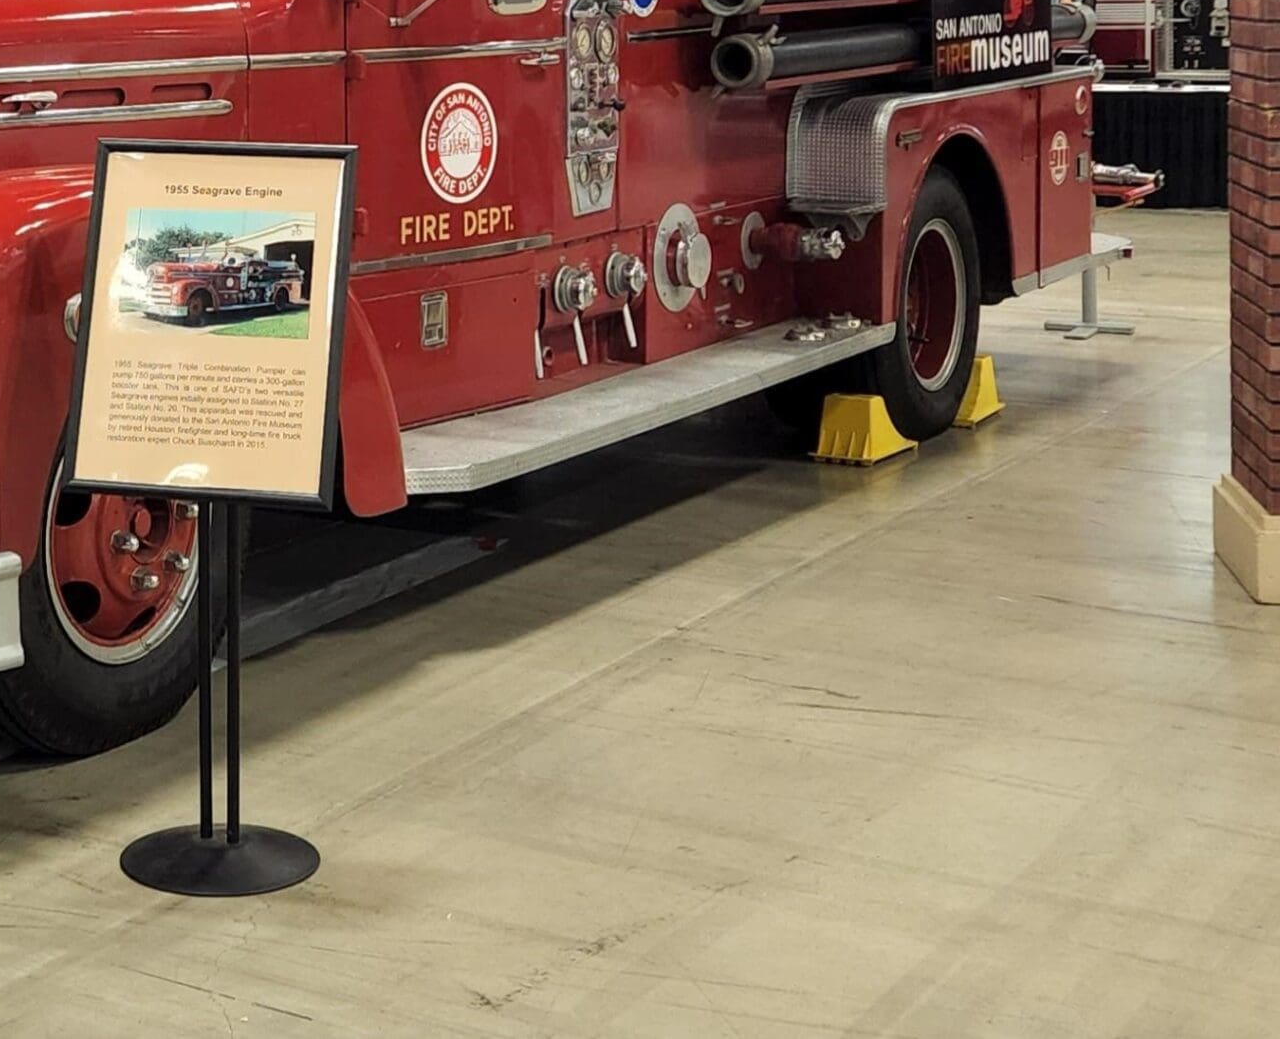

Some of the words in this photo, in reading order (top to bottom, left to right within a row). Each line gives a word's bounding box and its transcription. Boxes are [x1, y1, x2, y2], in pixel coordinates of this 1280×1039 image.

[936, 17, 957, 40] SAN
[959, 13, 1002, 37] ANTONIO
[428, 121, 439, 151] CITY
[435, 104, 448, 120] OF
[447, 93, 465, 109] SAN
[467, 95, 492, 147] ANTONIO
[434, 167, 457, 194] FIRE
[165, 184, 189, 195] 1955
[192, 185, 242, 197] Seagrave
[245, 186, 283, 199] Engine
[401, 213, 450, 246] FIRE
[464, 205, 514, 237] DEPT.
[179, 363, 198, 371] Triple
[204, 364, 251, 373] Combination
[257, 367, 285, 375] Pumper
[177, 375, 189, 383] per
[190, 374, 214, 382] minute
[166, 383, 179, 391] This
[150, 394, 178, 402] engines
[207, 397, 239, 405] assigned
[251, 398, 277, 406] Station
[200, 407, 236, 416] apparatus
[222, 418, 250, 426] Antonio
[253, 419, 267, 427] Fire
[269, 421, 302, 429] Museum
[119, 424, 142, 432] retired
[145, 425, 175, 433] Houston
[178, 427, 212, 436] firefighter
[282, 432, 301, 440] truck
[172, 437, 195, 445] Chuck
